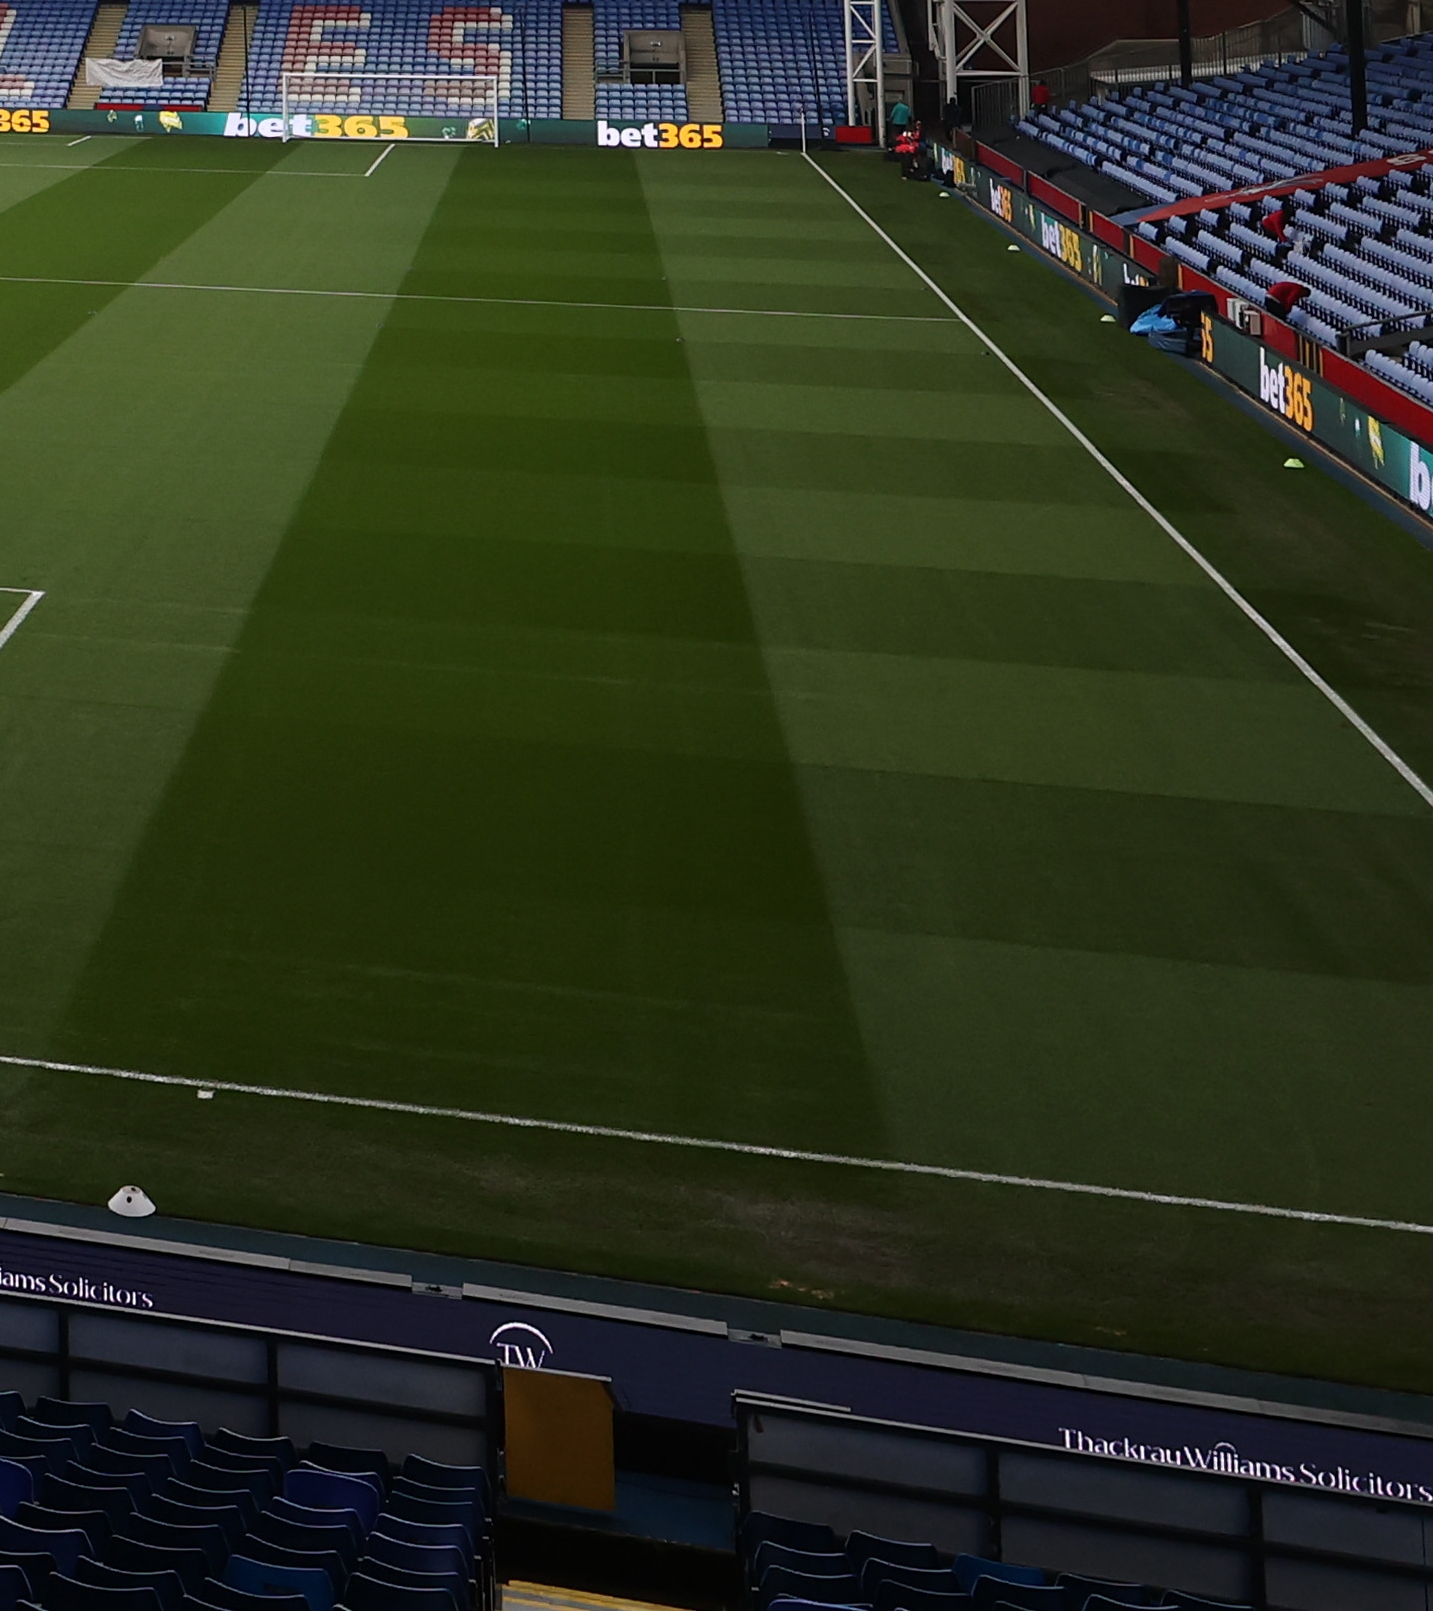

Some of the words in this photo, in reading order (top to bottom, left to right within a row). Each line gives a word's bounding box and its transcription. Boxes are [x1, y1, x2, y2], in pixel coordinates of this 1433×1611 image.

[224, 112, 409, 138] bet365
[598, 121, 722, 148] bet365
[1041, 212, 1082, 272] bet365
[1259, 347, 1313, 432] bet365
[48, 1273, 154, 1309] Solicitors
[1299, 1462, 1433, 1502] Solicitors
